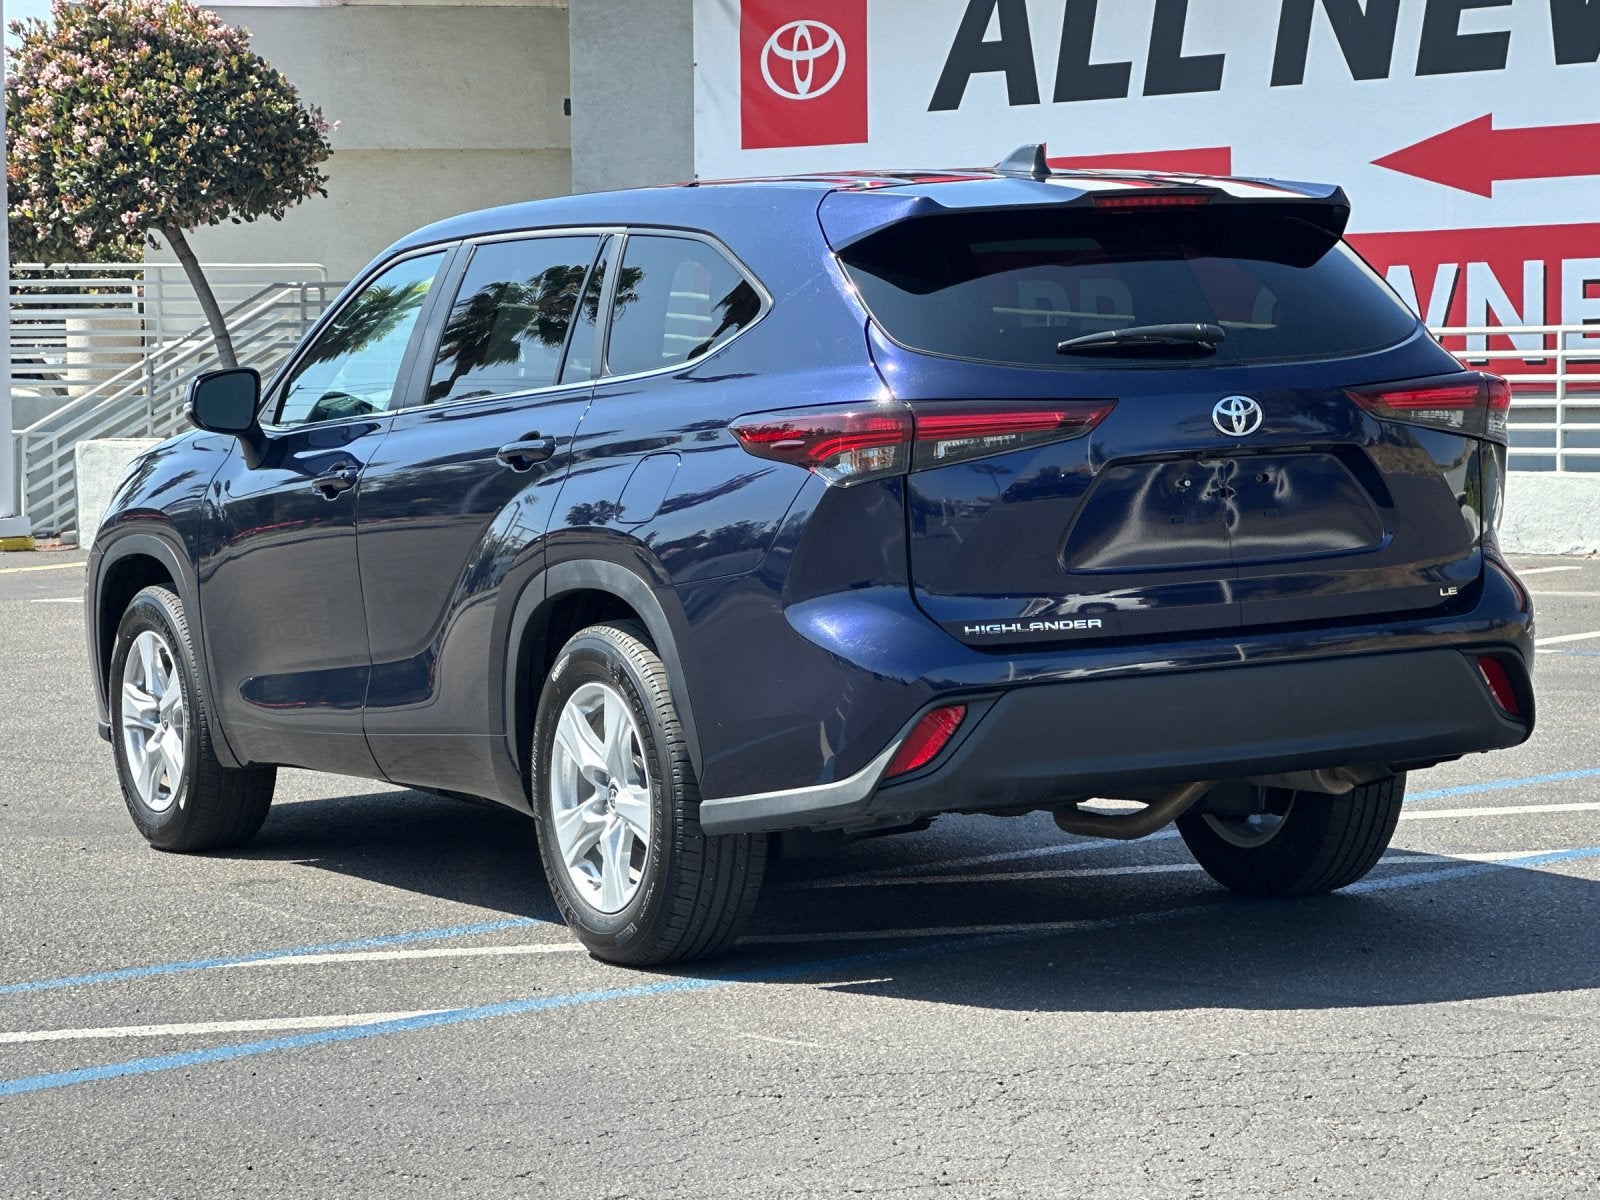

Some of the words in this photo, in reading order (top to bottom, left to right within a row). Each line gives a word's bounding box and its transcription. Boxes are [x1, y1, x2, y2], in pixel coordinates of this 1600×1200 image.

[927, 0, 1225, 112] ALL
[1439, 586, 1458, 597] LE
[964, 618, 1103, 636] HIGHLANDER
